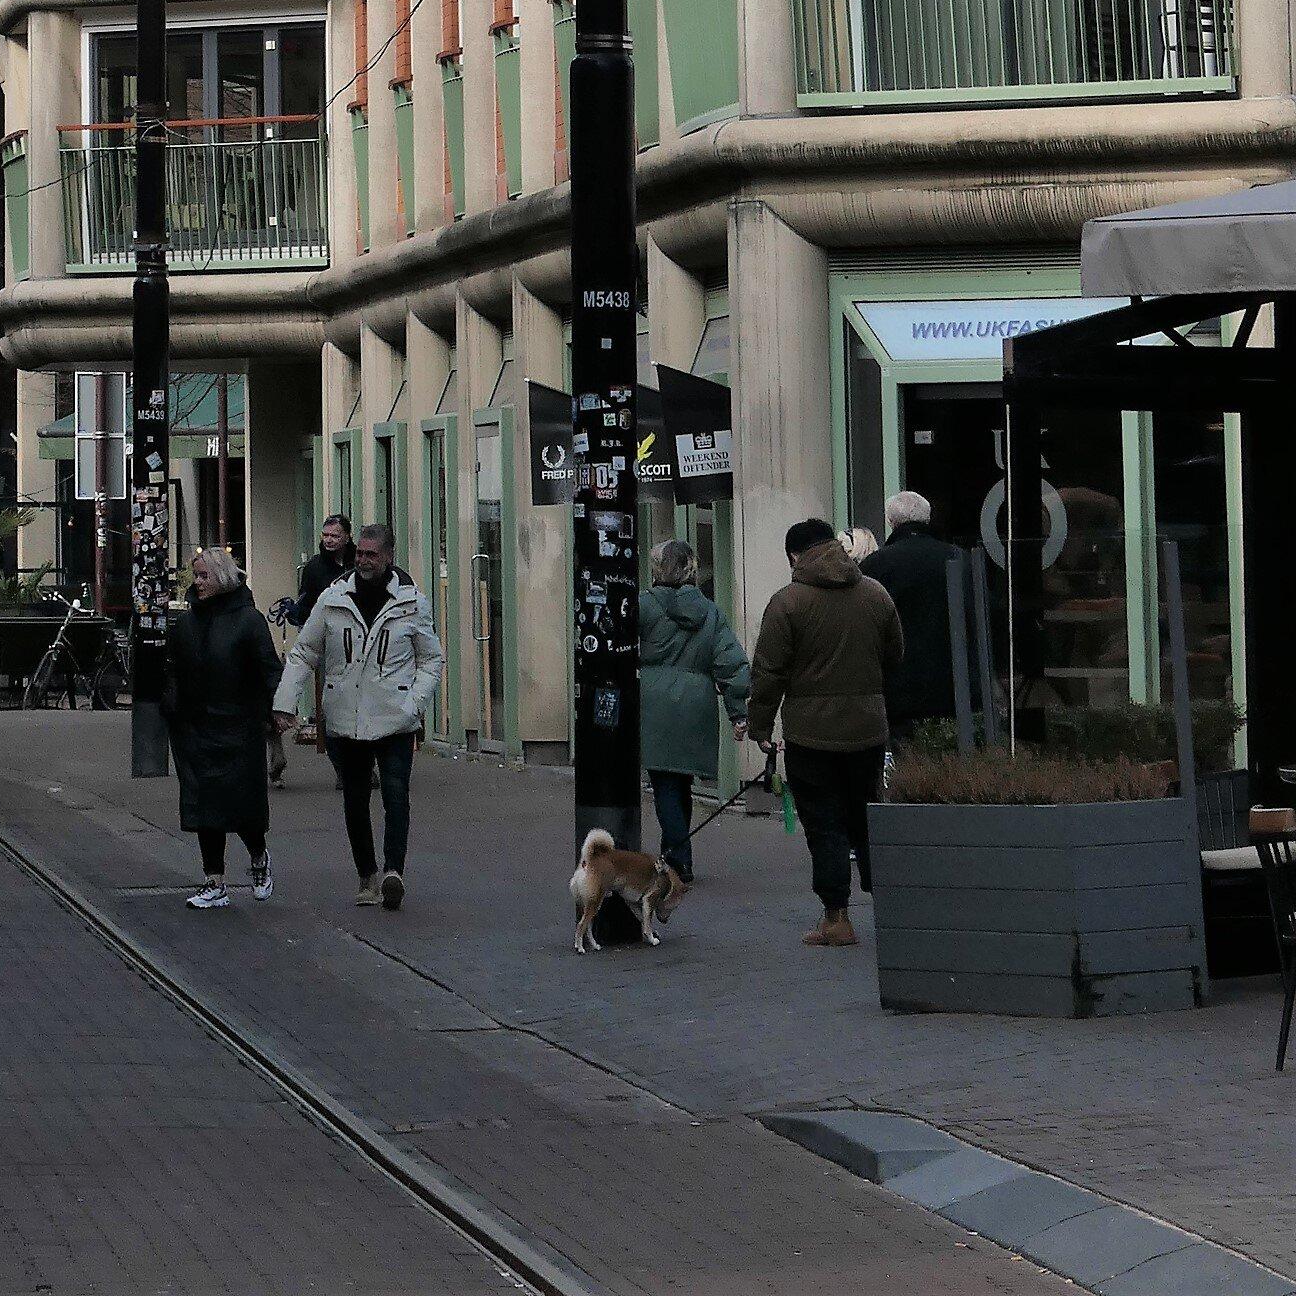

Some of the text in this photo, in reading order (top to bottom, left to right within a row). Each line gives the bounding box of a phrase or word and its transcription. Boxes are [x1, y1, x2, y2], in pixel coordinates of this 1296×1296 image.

[583, 290, 630, 308] M5438
[137, 409, 165, 420] M5439
[683, 451, 729, 463] WEEKEND
[638, 464, 671, 476] SCOTT
[683, 460, 730, 472] OFFENDER
[541, 469, 566, 481] FRED
